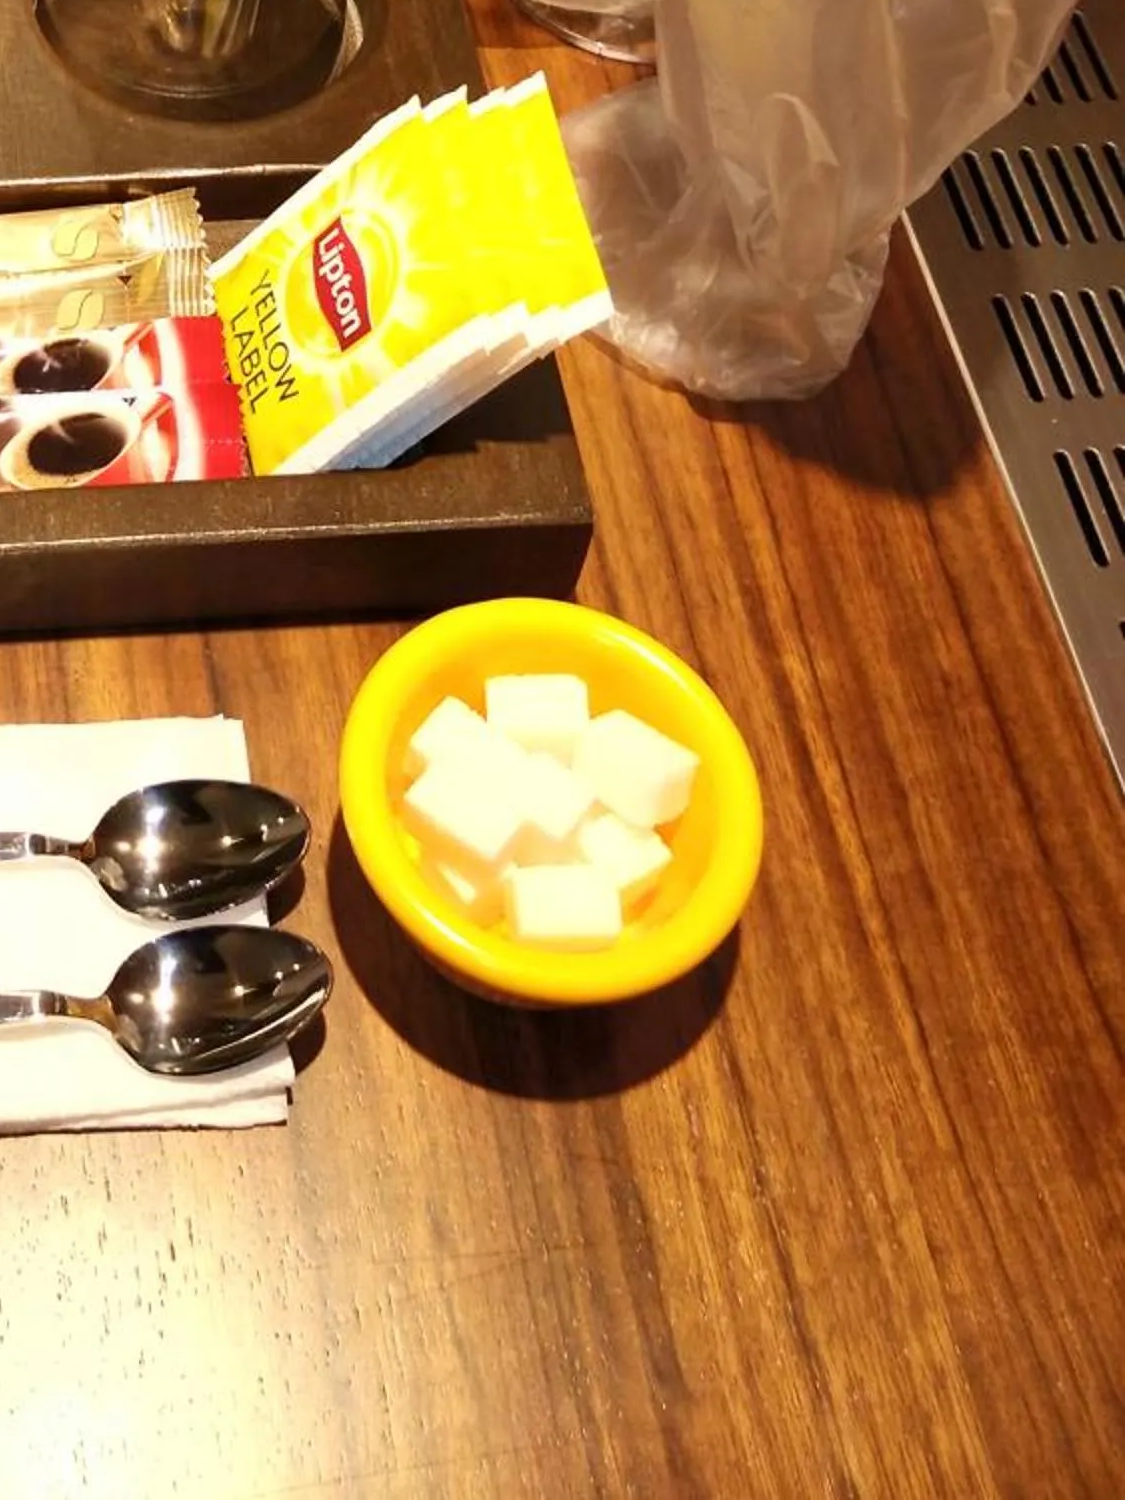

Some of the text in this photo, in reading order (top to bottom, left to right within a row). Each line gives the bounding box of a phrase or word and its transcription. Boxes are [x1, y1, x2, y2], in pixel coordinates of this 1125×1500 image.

[248, 269, 300, 402] YELLOW
[317, 227, 363, 338] Lipton
[230, 307, 271, 414] LABEL
